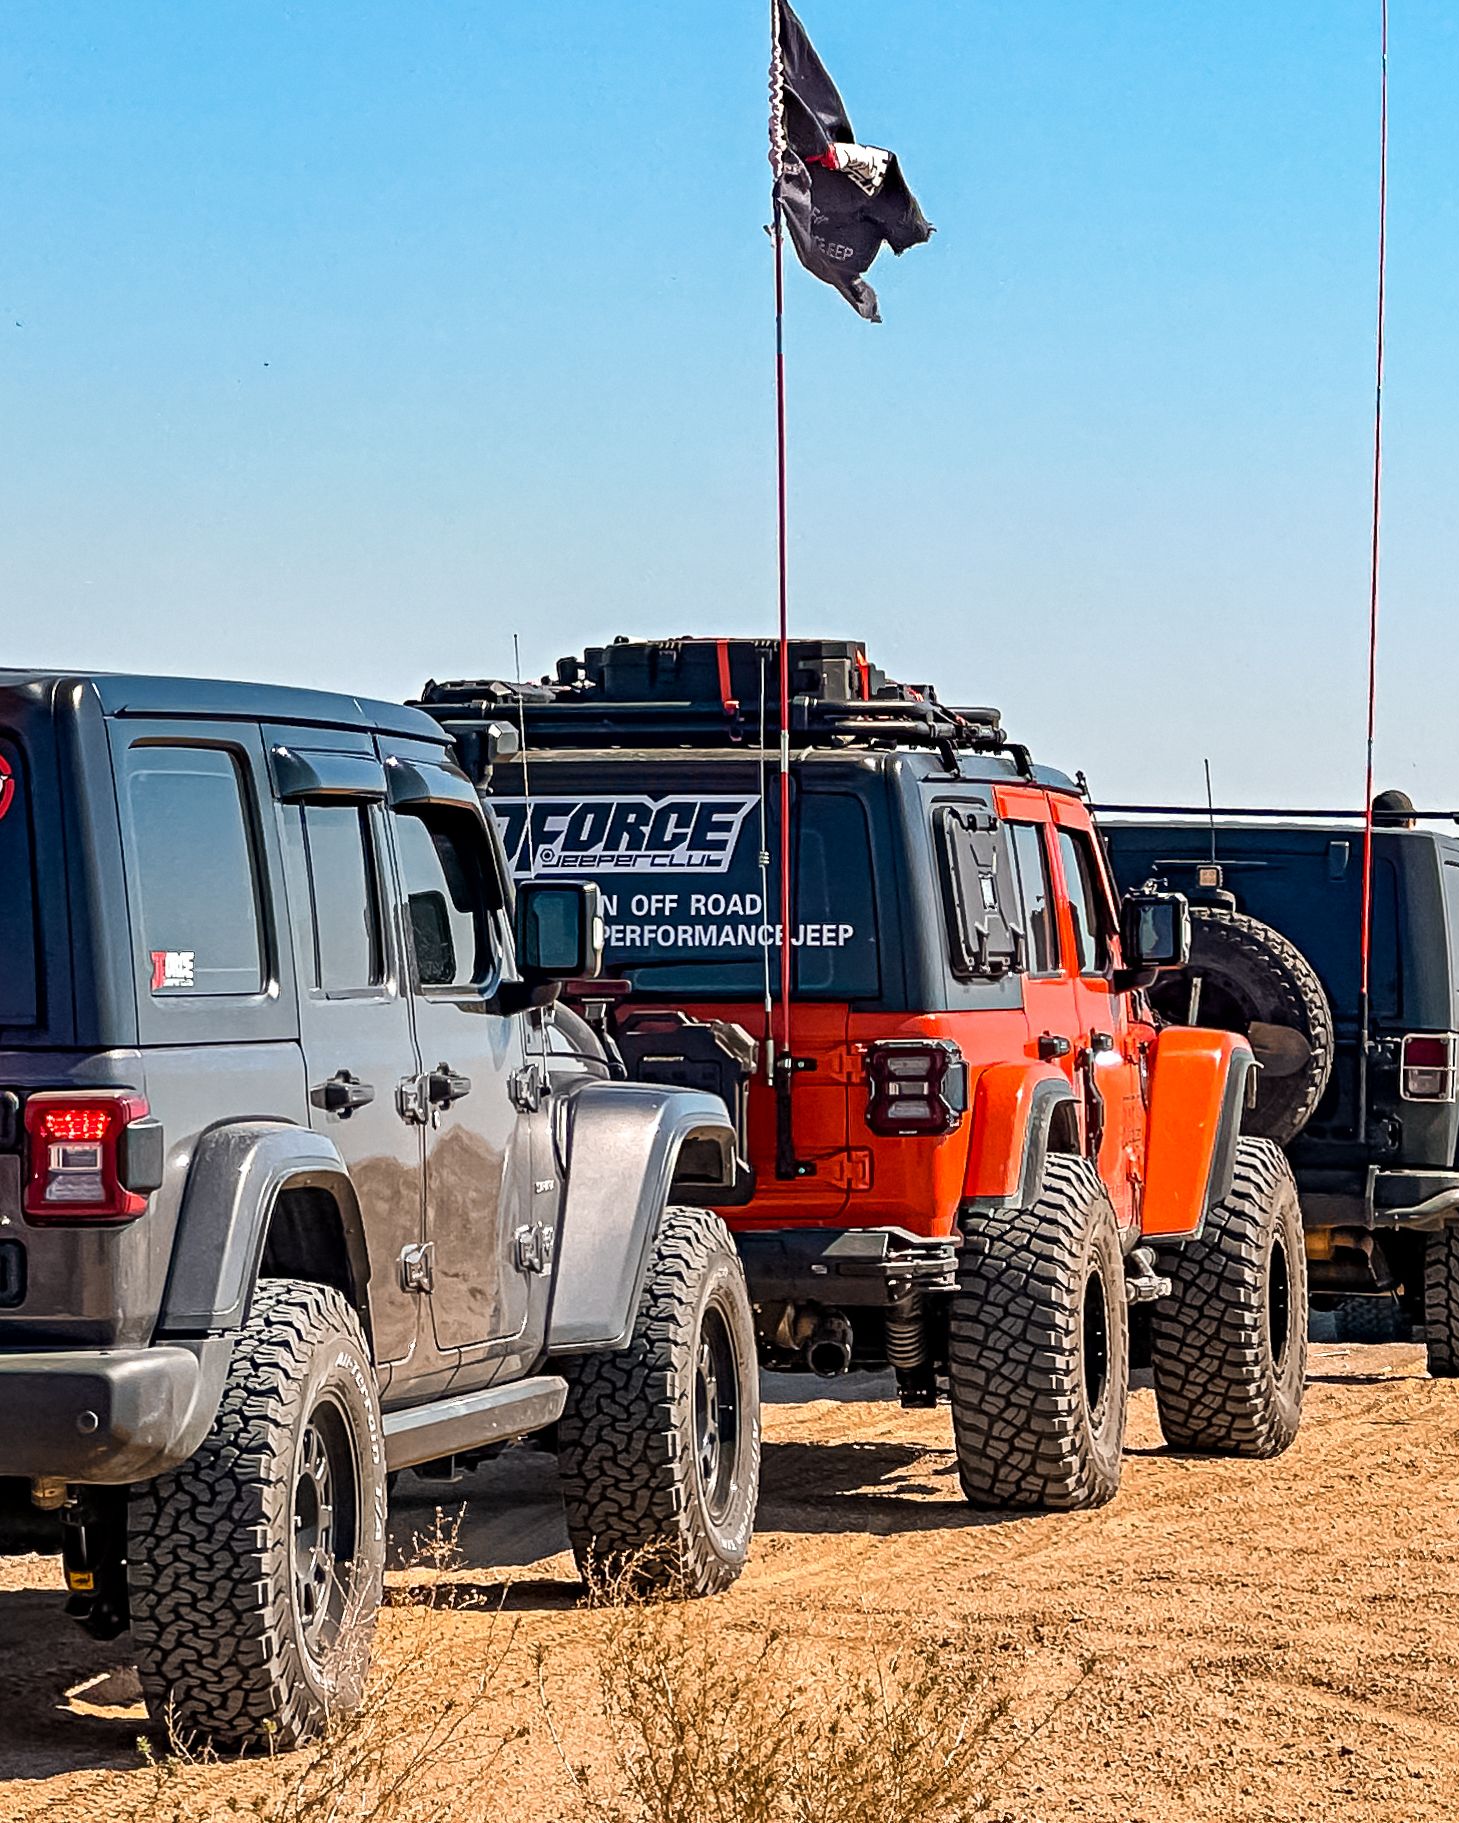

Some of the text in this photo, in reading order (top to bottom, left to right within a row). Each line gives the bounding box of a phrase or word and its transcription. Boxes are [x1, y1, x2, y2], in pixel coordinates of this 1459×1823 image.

[630, 894, 679, 916] OFF
[690, 893, 762, 916] ROAD
[790, 924, 854, 946] JEEP
